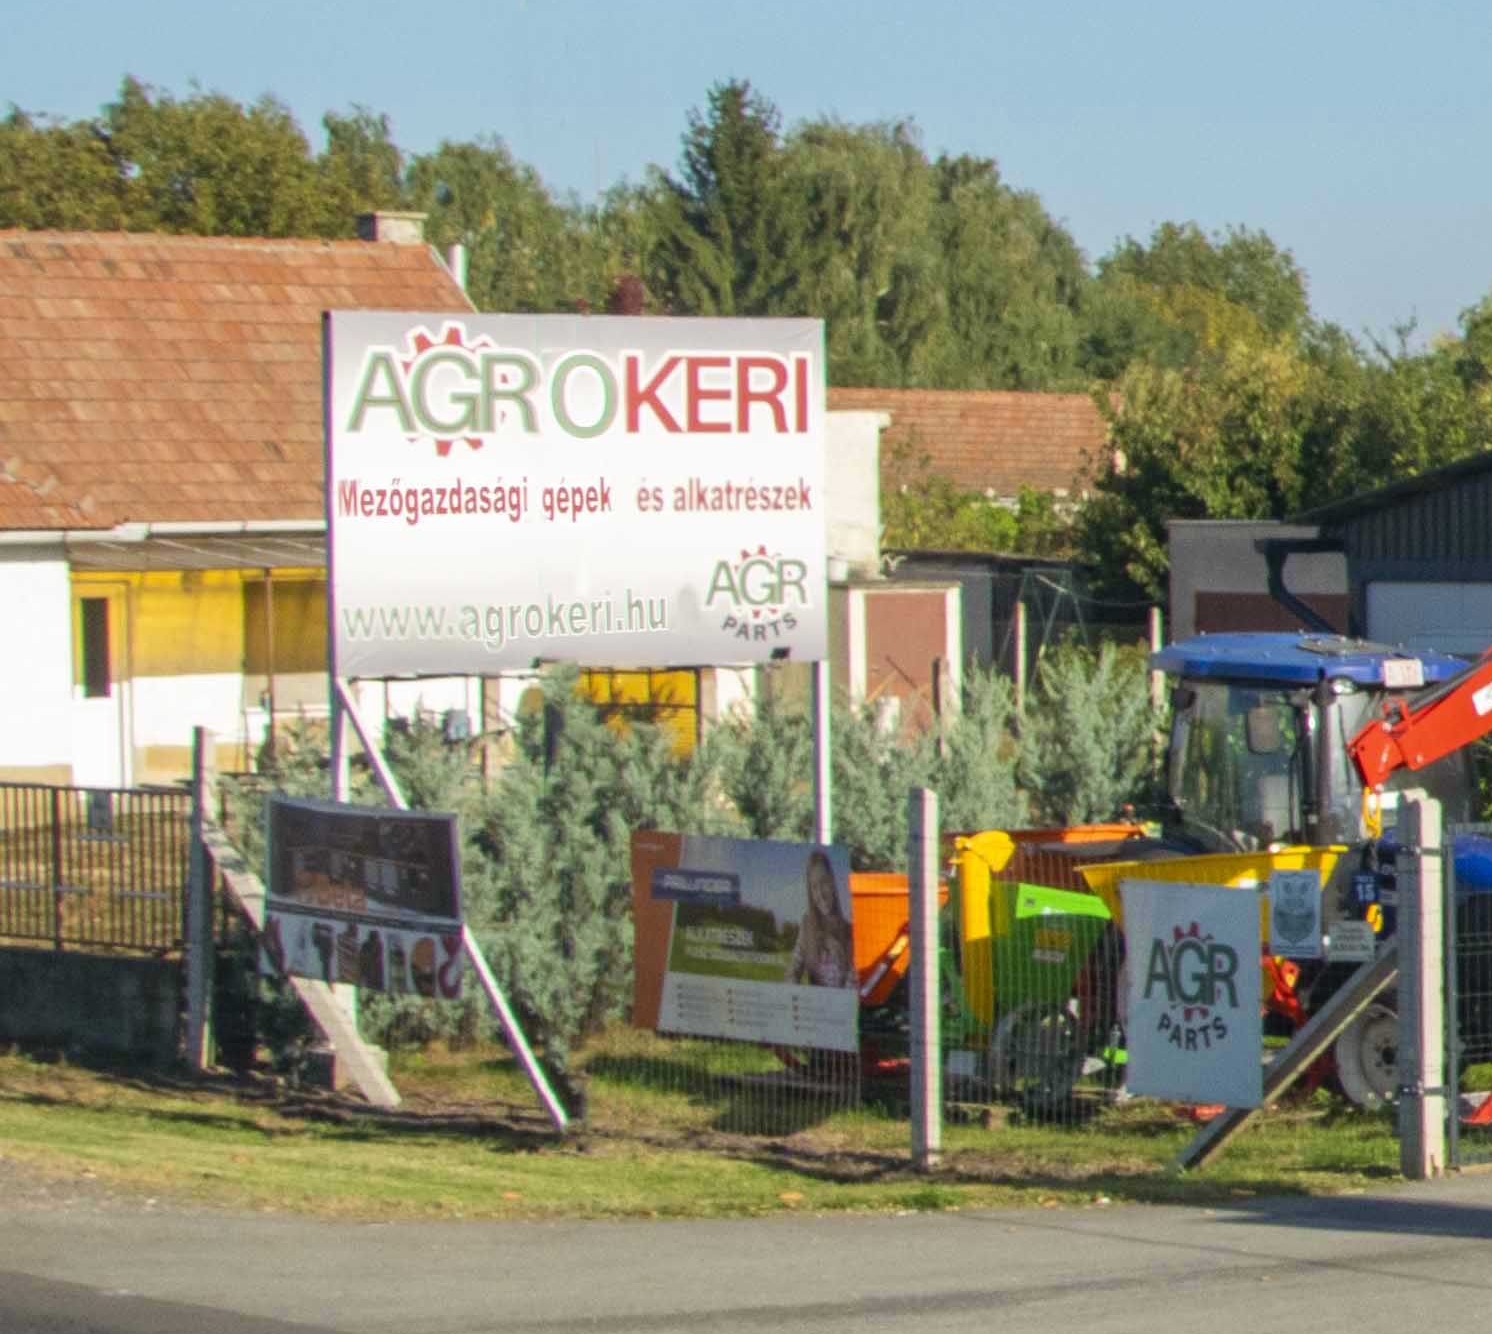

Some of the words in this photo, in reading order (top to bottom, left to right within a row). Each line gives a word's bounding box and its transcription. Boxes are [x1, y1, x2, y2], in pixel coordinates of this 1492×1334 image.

[346, 349, 809, 439] AGROKERI
[338, 477, 529, 526] Mezőgazdasági
[542, 477, 612, 522] gépek
[637, 477, 664, 513] és
[673, 477, 813, 513] alkatrészek
[705, 558, 808, 607] AGR
[341, 588, 670, 647] www.agrokeri.hu
[720, 611, 799, 643] PARTS
[1144, 937, 1239, 1009] AGR
[1157, 1012, 1229, 1052] PARTS
